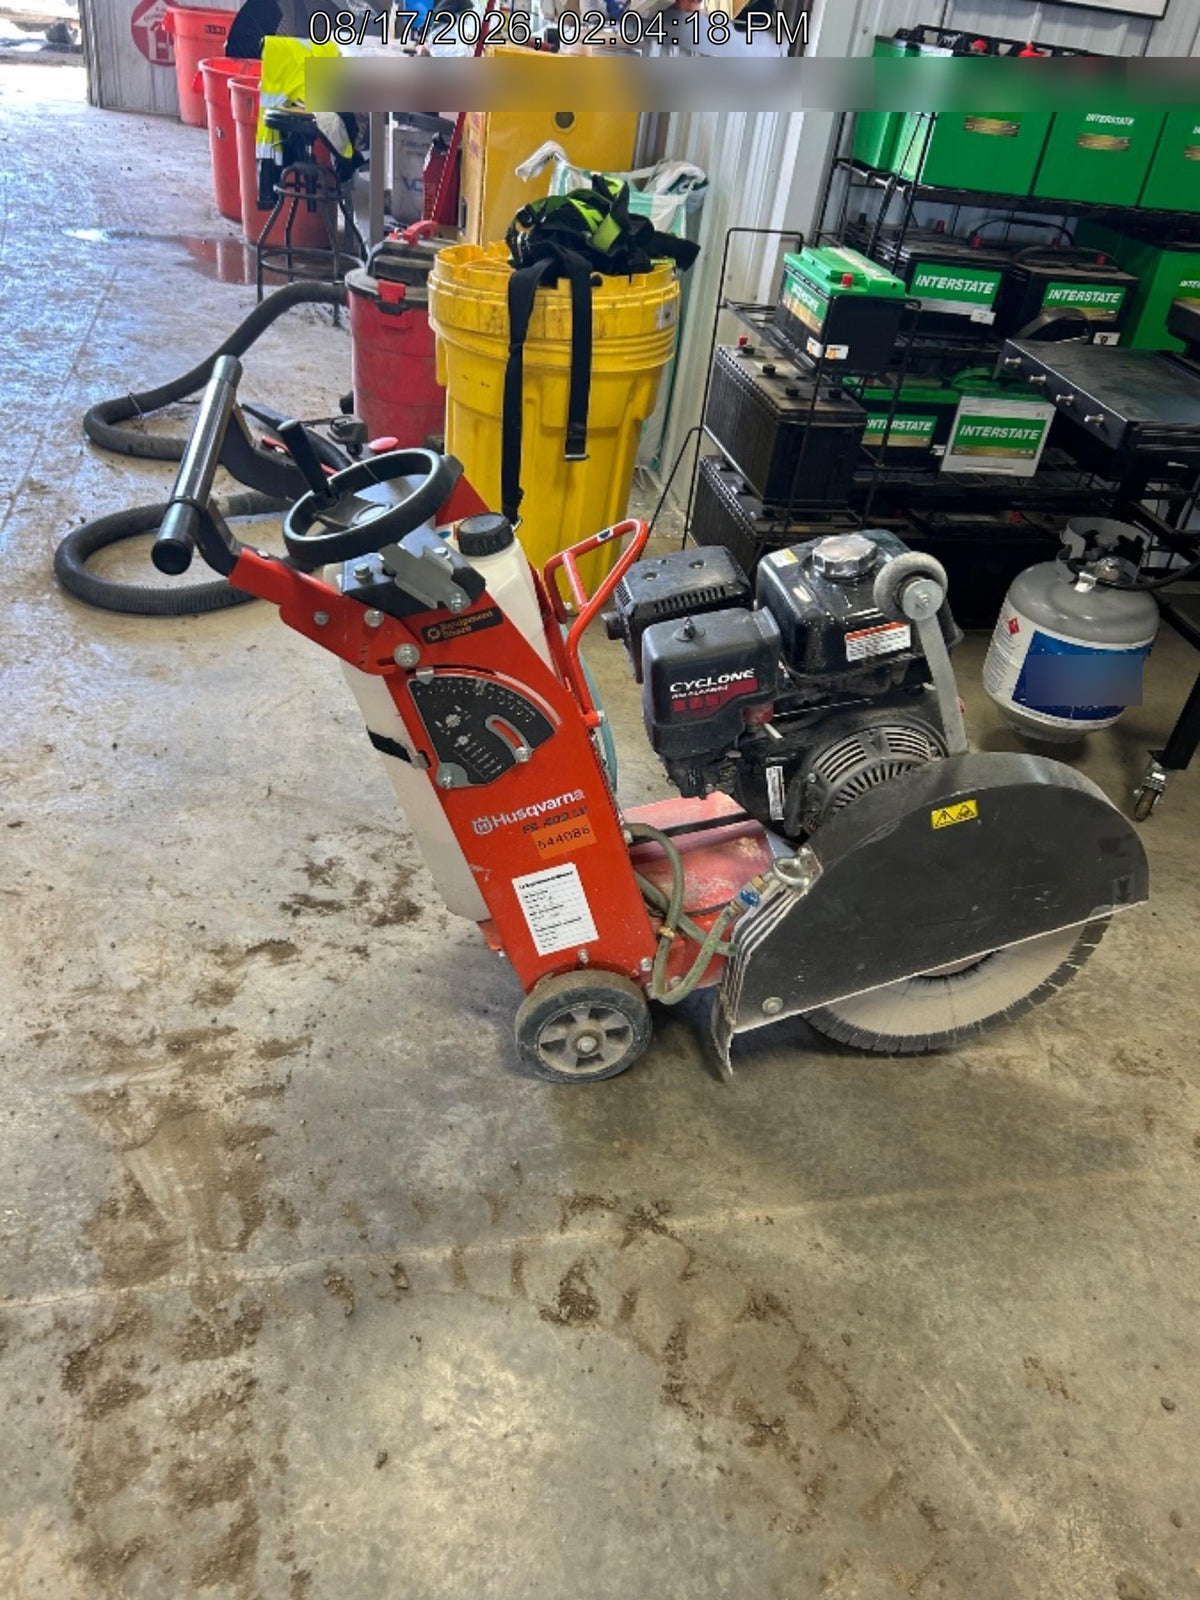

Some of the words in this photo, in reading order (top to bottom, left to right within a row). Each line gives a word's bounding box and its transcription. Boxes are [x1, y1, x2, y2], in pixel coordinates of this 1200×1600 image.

[915, 274, 995, 294] INTERSTATE
[1048, 288, 1121, 303] INTERSTATE
[866, 419, 933, 431] INTRSTATE
[959, 424, 1042, 440] INTERSTATE
[669, 668, 756, 693] CYCLONE
[491, 789, 586, 828] Husqvarna
